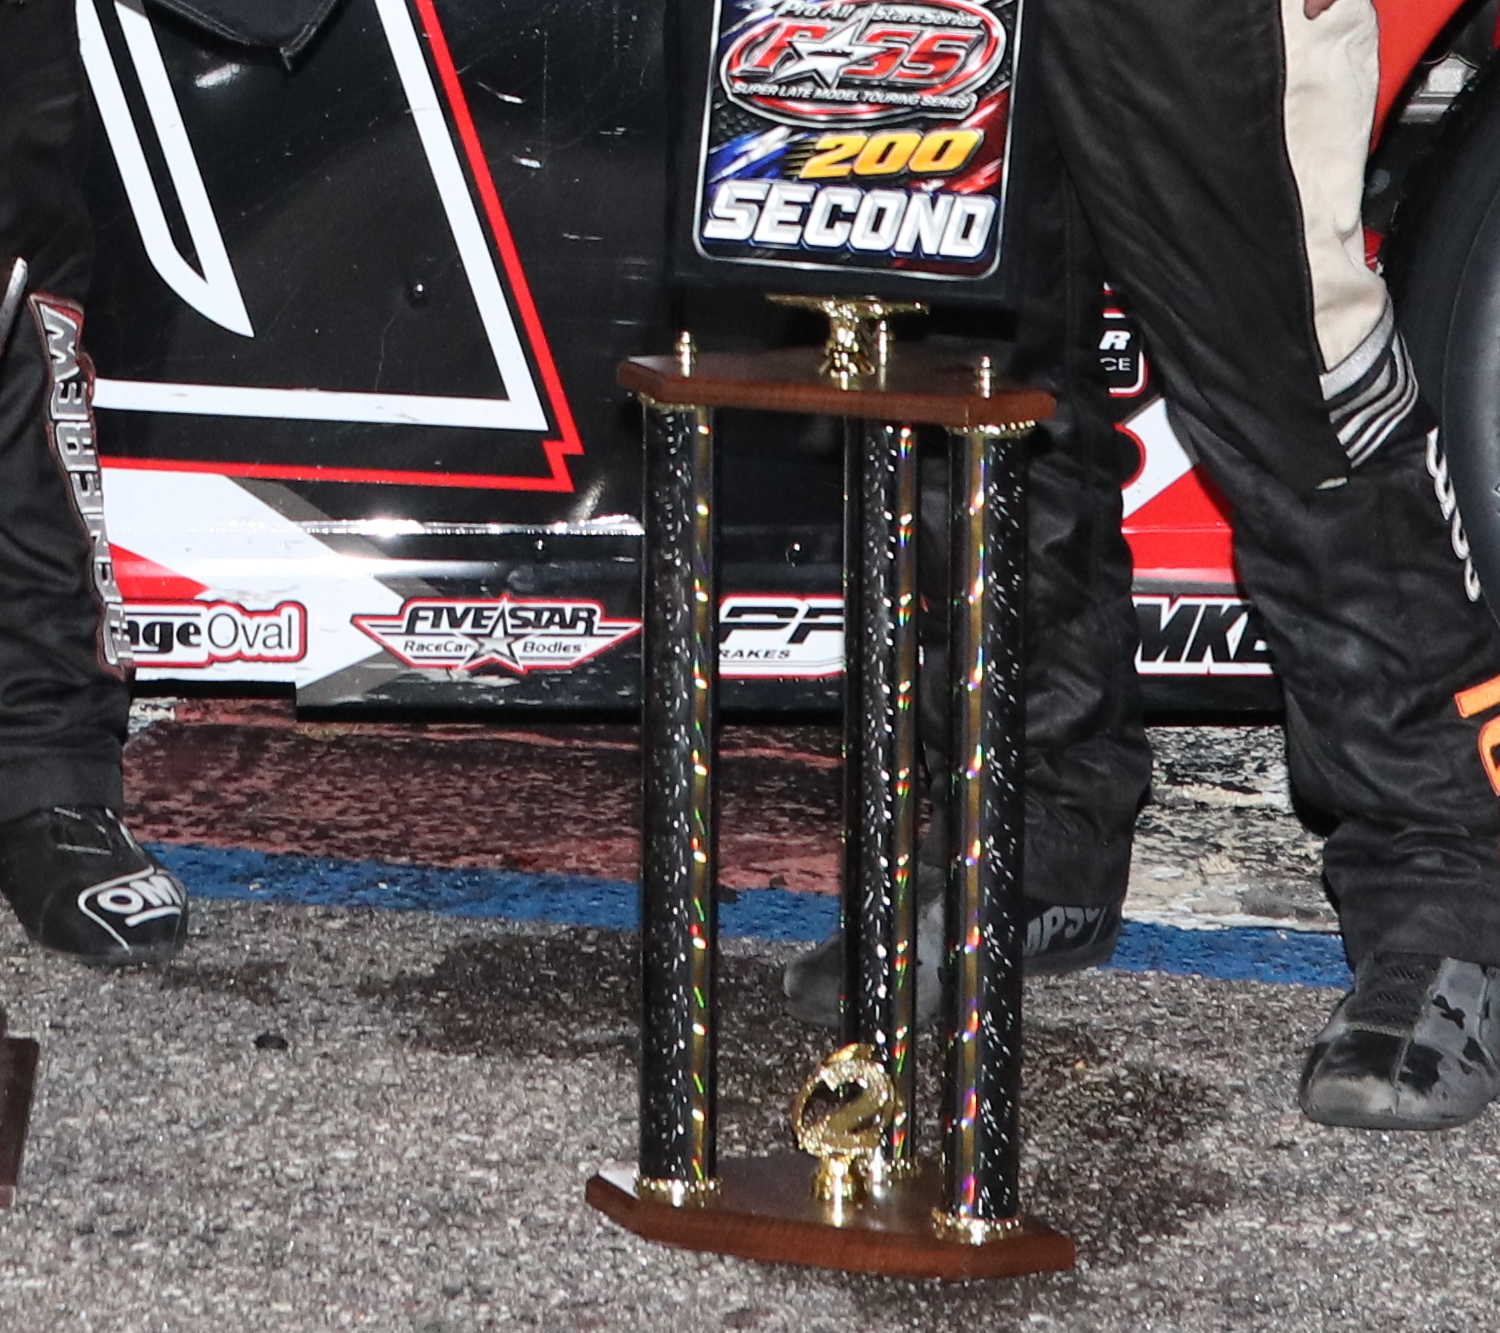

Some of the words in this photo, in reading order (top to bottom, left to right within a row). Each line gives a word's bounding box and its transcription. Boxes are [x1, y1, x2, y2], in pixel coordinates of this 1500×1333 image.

[730, 82, 779, 97] SUPER
[779, 85, 812, 100] LATE
[813, 87, 858, 102] MODEL
[861, 90, 919, 105] TOURING
[920, 94, 970, 109] SERIES
[799, 130, 985, 180] 200
[702, 183, 999, 259] SECOND
[403, 607, 500, 633] FIVE
[504, 607, 599, 633] STAR
[521, 639, 584, 655] Bodies
